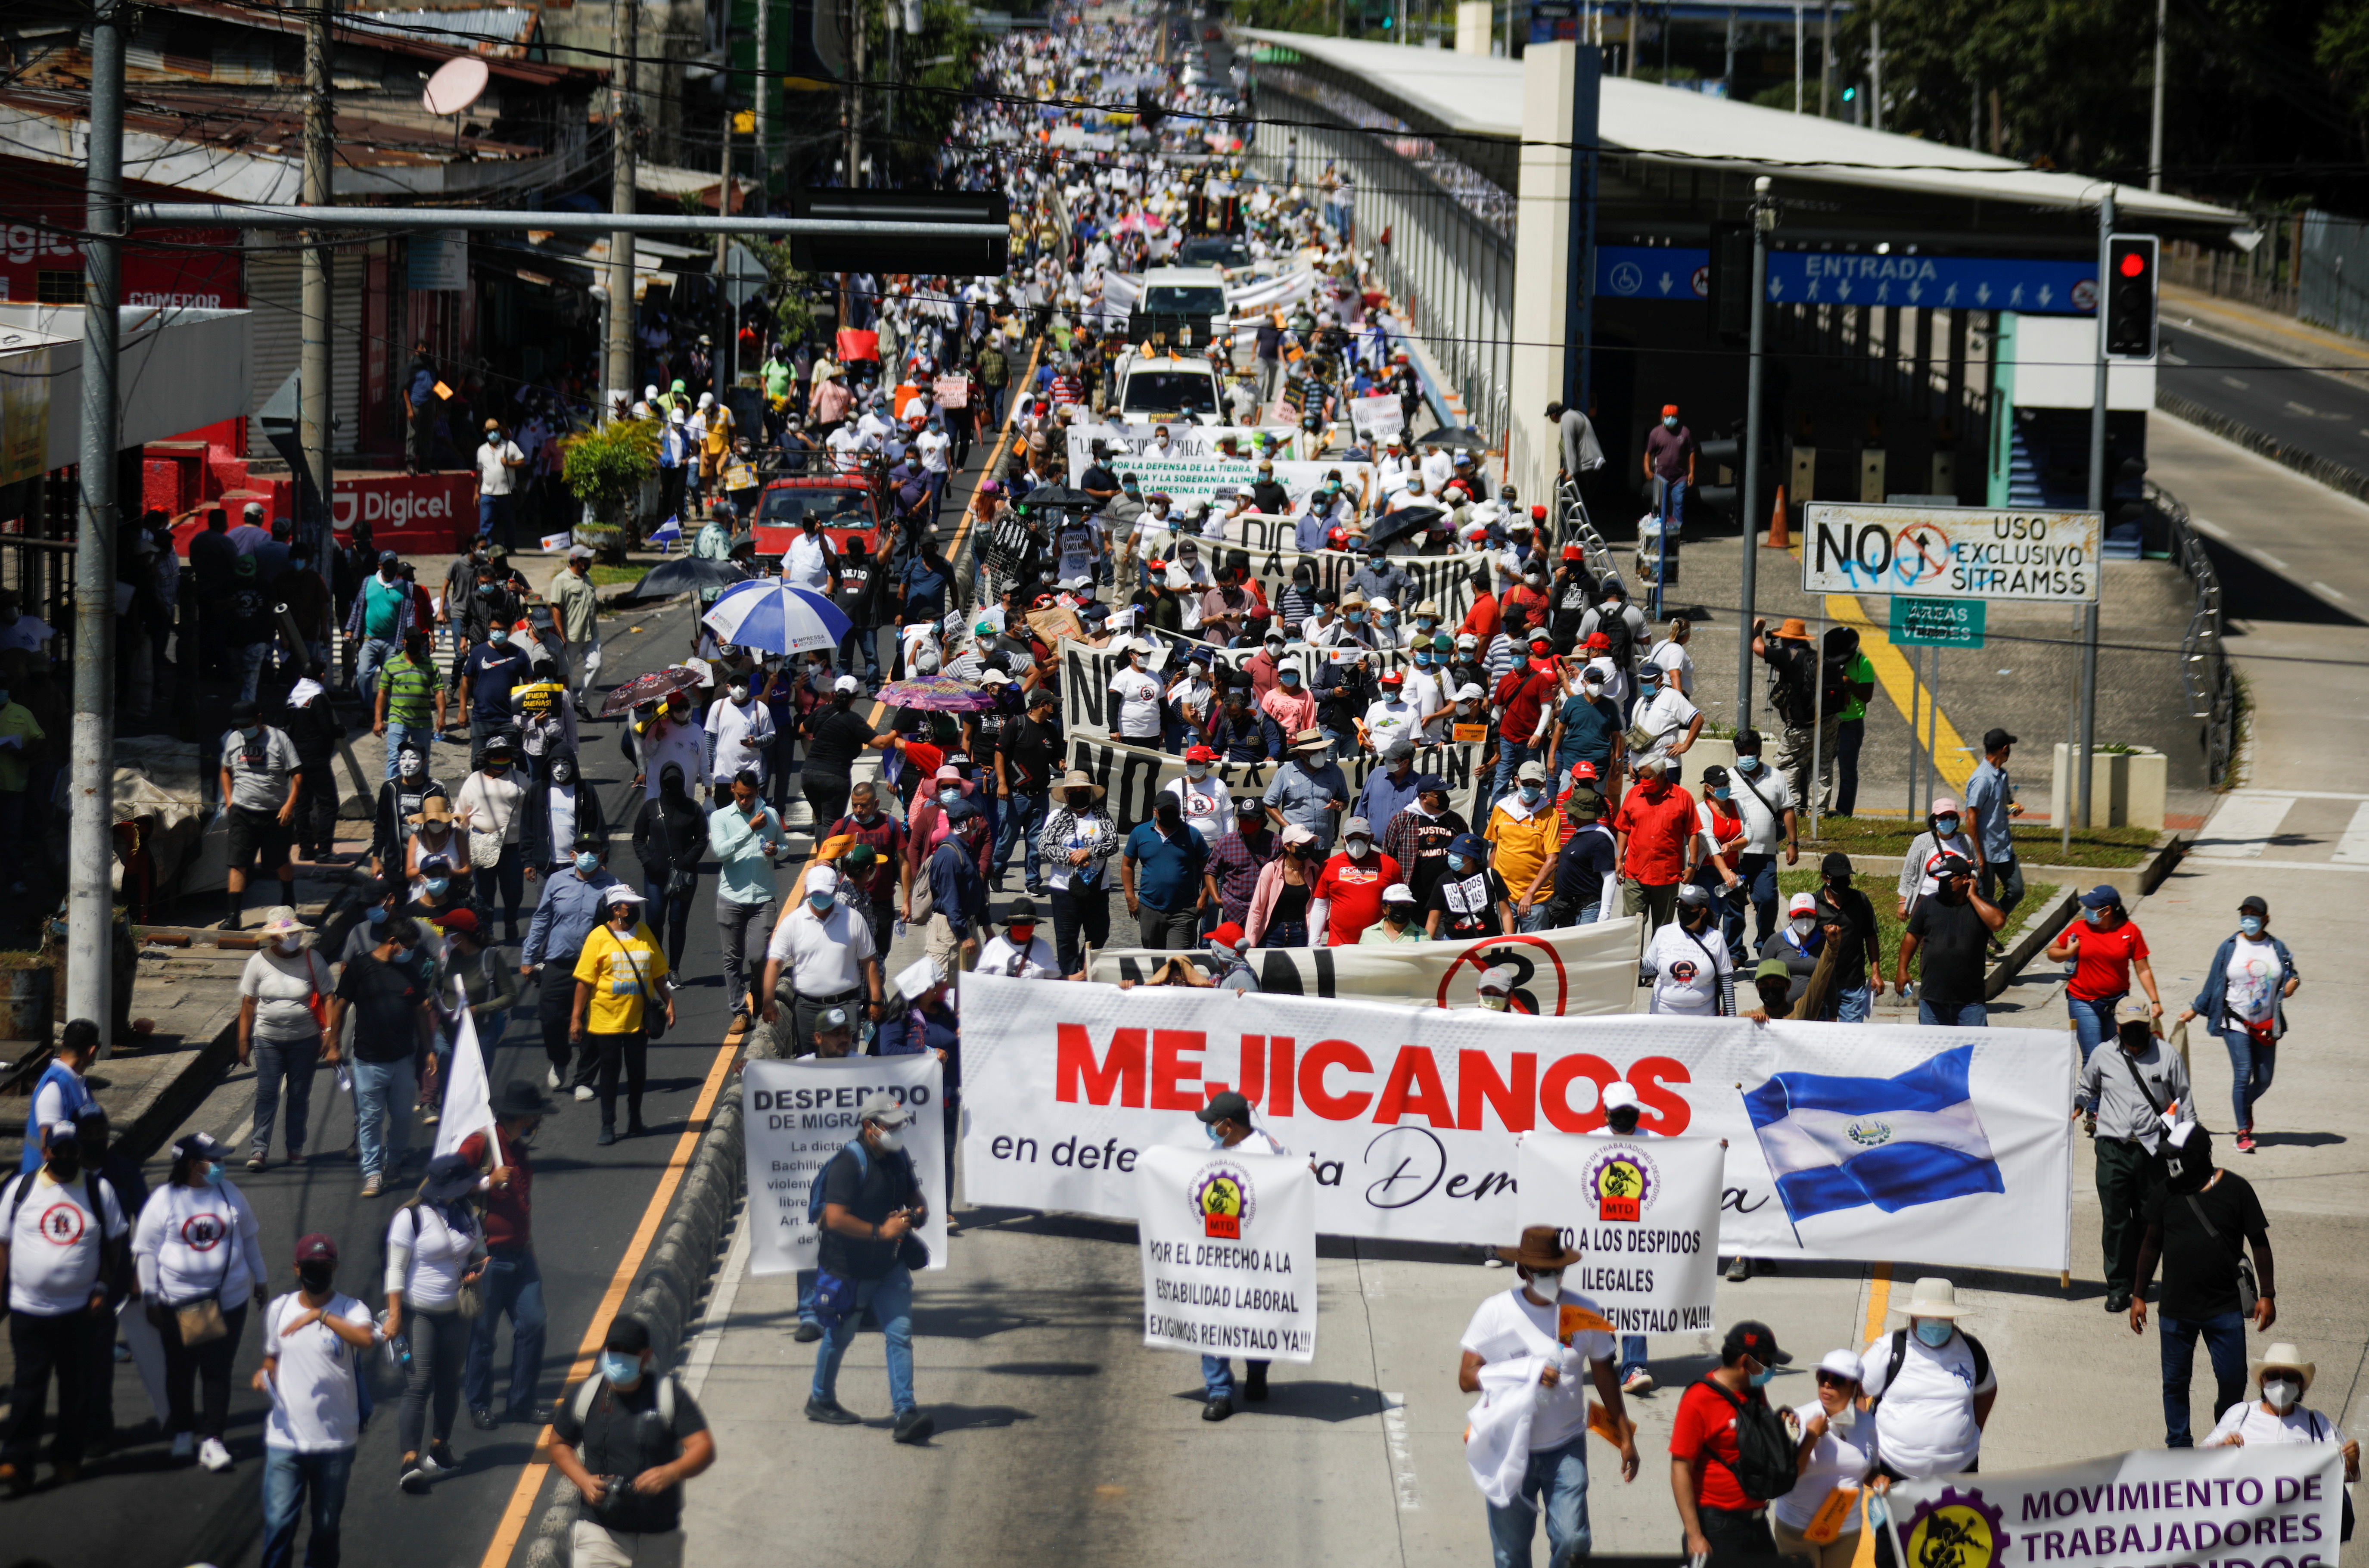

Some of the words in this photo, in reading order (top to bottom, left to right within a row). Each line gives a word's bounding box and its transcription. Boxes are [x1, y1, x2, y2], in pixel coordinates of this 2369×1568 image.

[1805, 255, 1937, 281] ENTRADA
[130, 292, 221, 309] COMEDOR
[1146, 462, 1187, 471] DEFENSA
[1190, 463, 1202, 471] DE
[1204, 464, 1216, 472] LA
[1219, 464, 1253, 473] TIERRA,
[1152, 473, 1158, 482] Y
[1174, 473, 1225, 483] SOBERANÍA
[1143, 485, 1195, 494] CAMPESINA
[1198, 486, 1210, 494] EN
[365, 490, 453, 527] Digicel
[1064, 542, 1078, 551] SOMOS
[1816, 523, 1893, 575] NO
[1994, 516, 2046, 541] USO
[1956, 543, 2083, 567] EXCLUSIVO
[1951, 567, 2086, 594] SITRAMSS
[797, 635, 825, 643] IMPRESSA
[798, 638, 826, 647] REPUESTOS
[522, 699, 552, 707] DUEÑAS!
[1247, 736, 1260, 746] ES
[1418, 826, 1452, 837] OUSTON
[1447, 876, 1483, 897] ¡¡UIDOS
[1449, 895, 1471, 908] SOMS
[1055, 1022, 1692, 1138] MEJICANOS
[769, 1114, 795, 1130] DE
[802, 1110, 917, 1130] MIGRAN
[792, 1141, 808, 1153] La
[991, 1133, 1039, 1161] en
[1051, 1136, 1138, 1173] defe
[772, 1159, 825, 1172] Bachille
[767, 1179, 811, 1190] violent
[1580, 1161, 1596, 1210] MOVIMIENTO
[1590, 1151, 1600, 1162] DE
[1598, 1142, 1654, 1165] TRABAJADORES
[1643, 1164, 1661, 1211] DESPEDIDOS
[779, 1197, 808, 1207] libre
[1187, 1175, 1203, 1226] MOVIMIENTO
[1197, 1167, 1207, 1177] DE
[1206, 1158, 1253, 1183] TRABAJADORES
[1243, 1182, 1257, 1229] DESPEDIDOS
[1605, 1203, 1634, 1214] MTD
[780, 1216, 804, 1227] Art.
[1210, 1220, 1235, 1232] MTD
[798, 1234, 814, 1245] de
[1579, 1228, 1589, 1251] A
[1594, 1228, 1623, 1252] LOS
[1627, 1229, 1701, 1254] DESPIDOS
[1150, 1238, 1172, 1263] POR
[1176, 1241, 1191, 1265] EL
[1196, 1243, 1260, 1270] DERECHO
[1263, 1249, 1272, 1272] A
[1276, 1250, 1292, 1274] LA
[1582, 1266, 1654, 1292] ILEGALES
[1156, 1276, 1231, 1307] ESTABILIDAD
[1235, 1286, 1300, 1313] LABORAL
[1682, 1304, 1711, 1330] YA!!!
[1150, 1312, 1198, 1344] EXIGIMOS
[1200, 1322, 1278, 1350] REINSTALO
[1282, 1328, 1312, 1353] YA!!!
[2022, 1476, 2263, 1522] MOVIMIENTO
[2276, 1473, 2322, 1504] DE
[2020, 1512, 2322, 1562] TRABAJADORES
